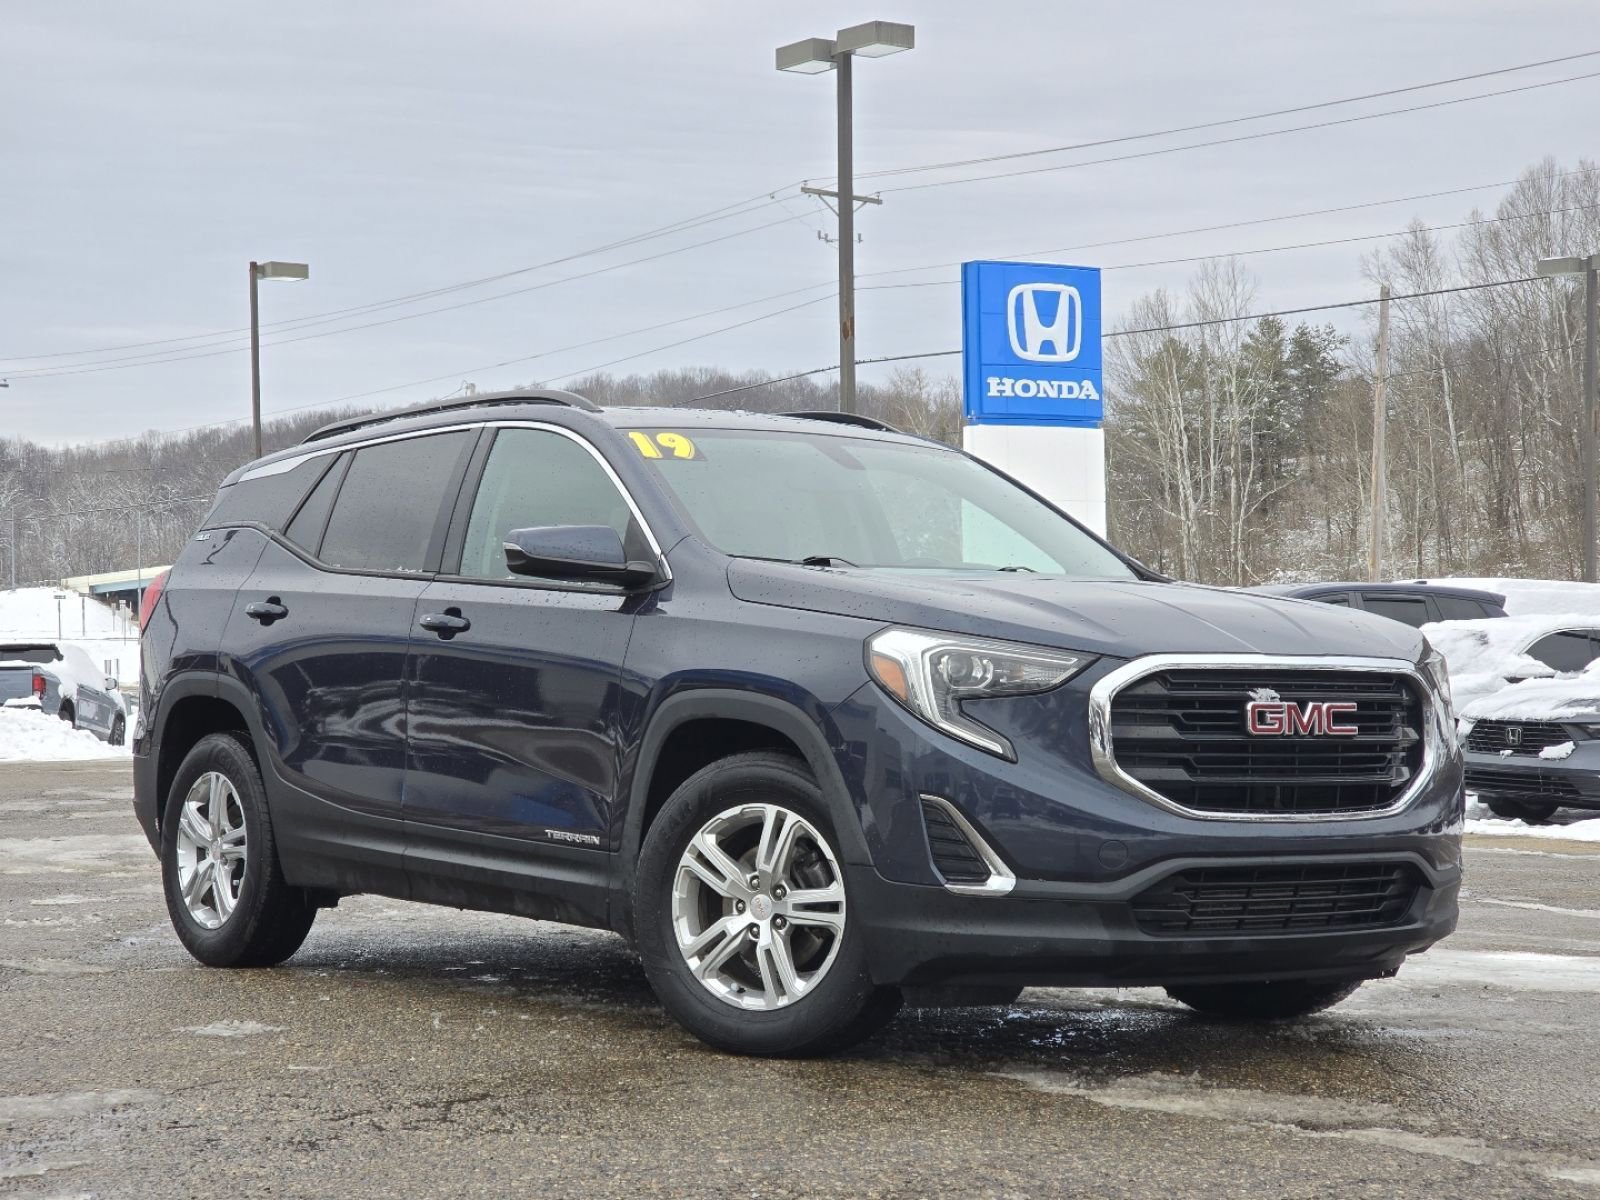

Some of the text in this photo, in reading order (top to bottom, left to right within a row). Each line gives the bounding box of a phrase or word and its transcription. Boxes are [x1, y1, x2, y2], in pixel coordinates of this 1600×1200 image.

[987, 377, 1099, 400] HONDA
[628, 431, 695, 459] 19
[1247, 702, 1358, 736] GMC
[544, 829, 600, 845] TERRAIN
